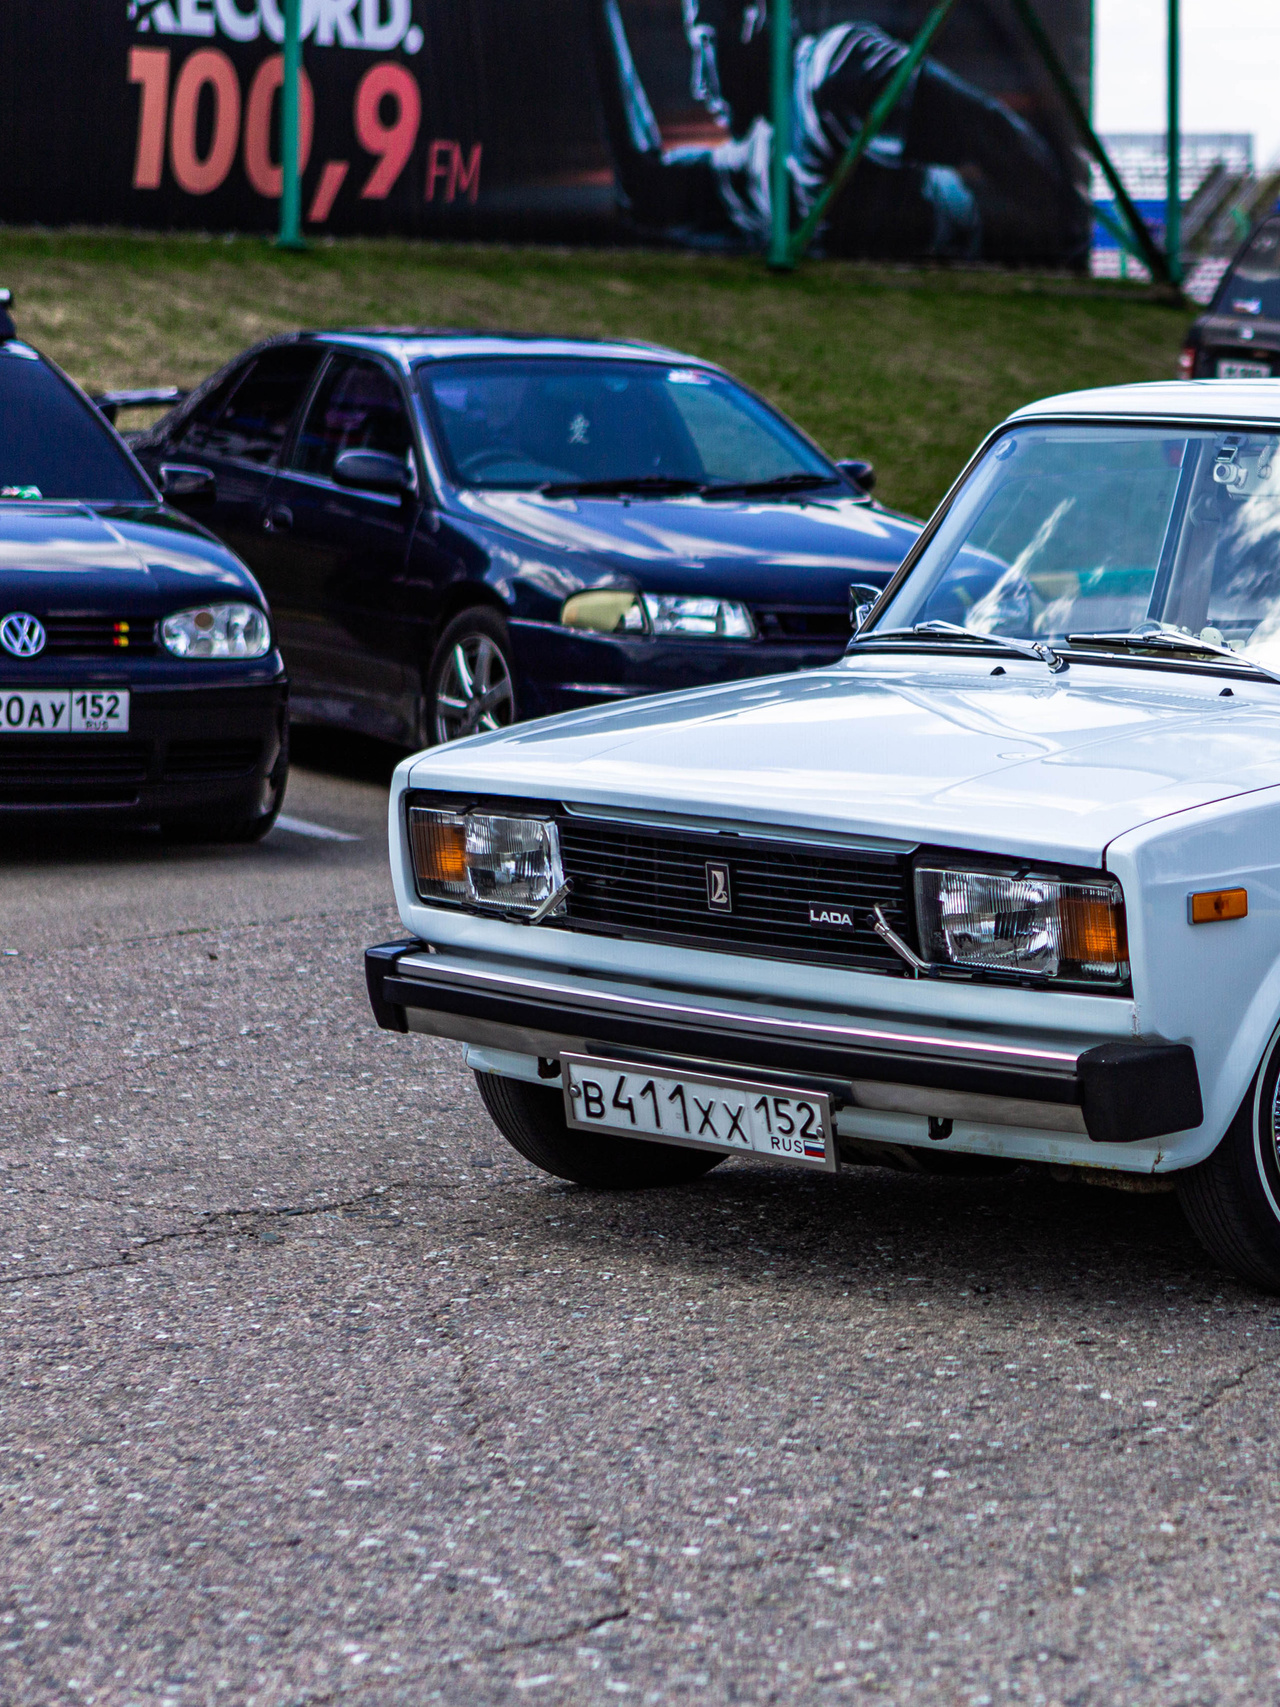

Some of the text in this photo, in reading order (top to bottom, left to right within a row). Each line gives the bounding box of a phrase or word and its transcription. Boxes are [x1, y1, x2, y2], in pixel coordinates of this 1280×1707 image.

[127, 46, 482, 222] 100,9 FM
[0, 695, 120, 727] 0АУ 152
[810, 909, 853, 926] LADA
[754, 1096, 825, 1140] 152
[771, 1136, 803, 1153] RUS
